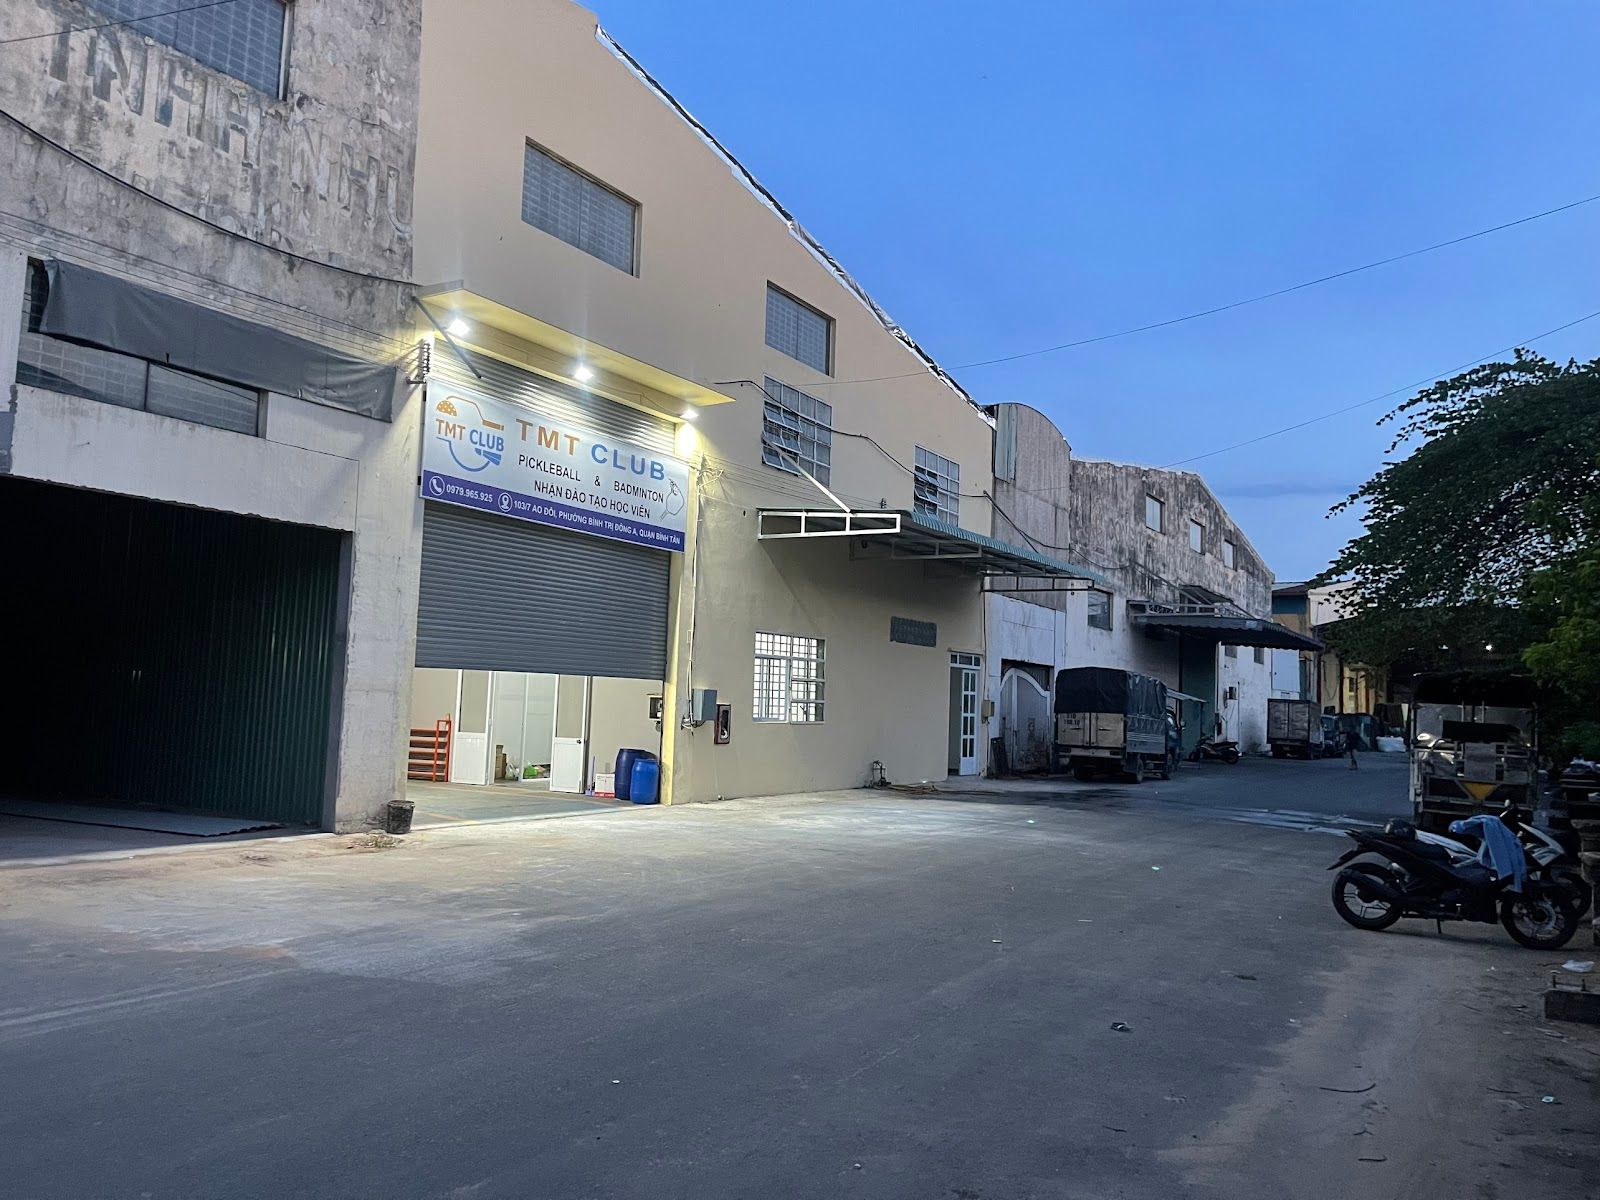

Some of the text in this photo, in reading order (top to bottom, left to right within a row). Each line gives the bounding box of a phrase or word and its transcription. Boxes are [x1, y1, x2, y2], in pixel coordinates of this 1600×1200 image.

[436, 418, 504, 452] TMT CLUB
[516, 418, 665, 481] TMT CLUB
[446, 484, 493, 503] 0979.965.925
[518, 454, 664, 503] PICKLEBALL & BADMINTON
[514, 500, 531, 511] 103/7
[532, 505, 542, 514] AO
[565, 487, 586, 503] ĐÀO
[589, 494, 607, 509] TẠO
[610, 499, 628, 514] HỌC
[631, 504, 650, 519] VIÊN
